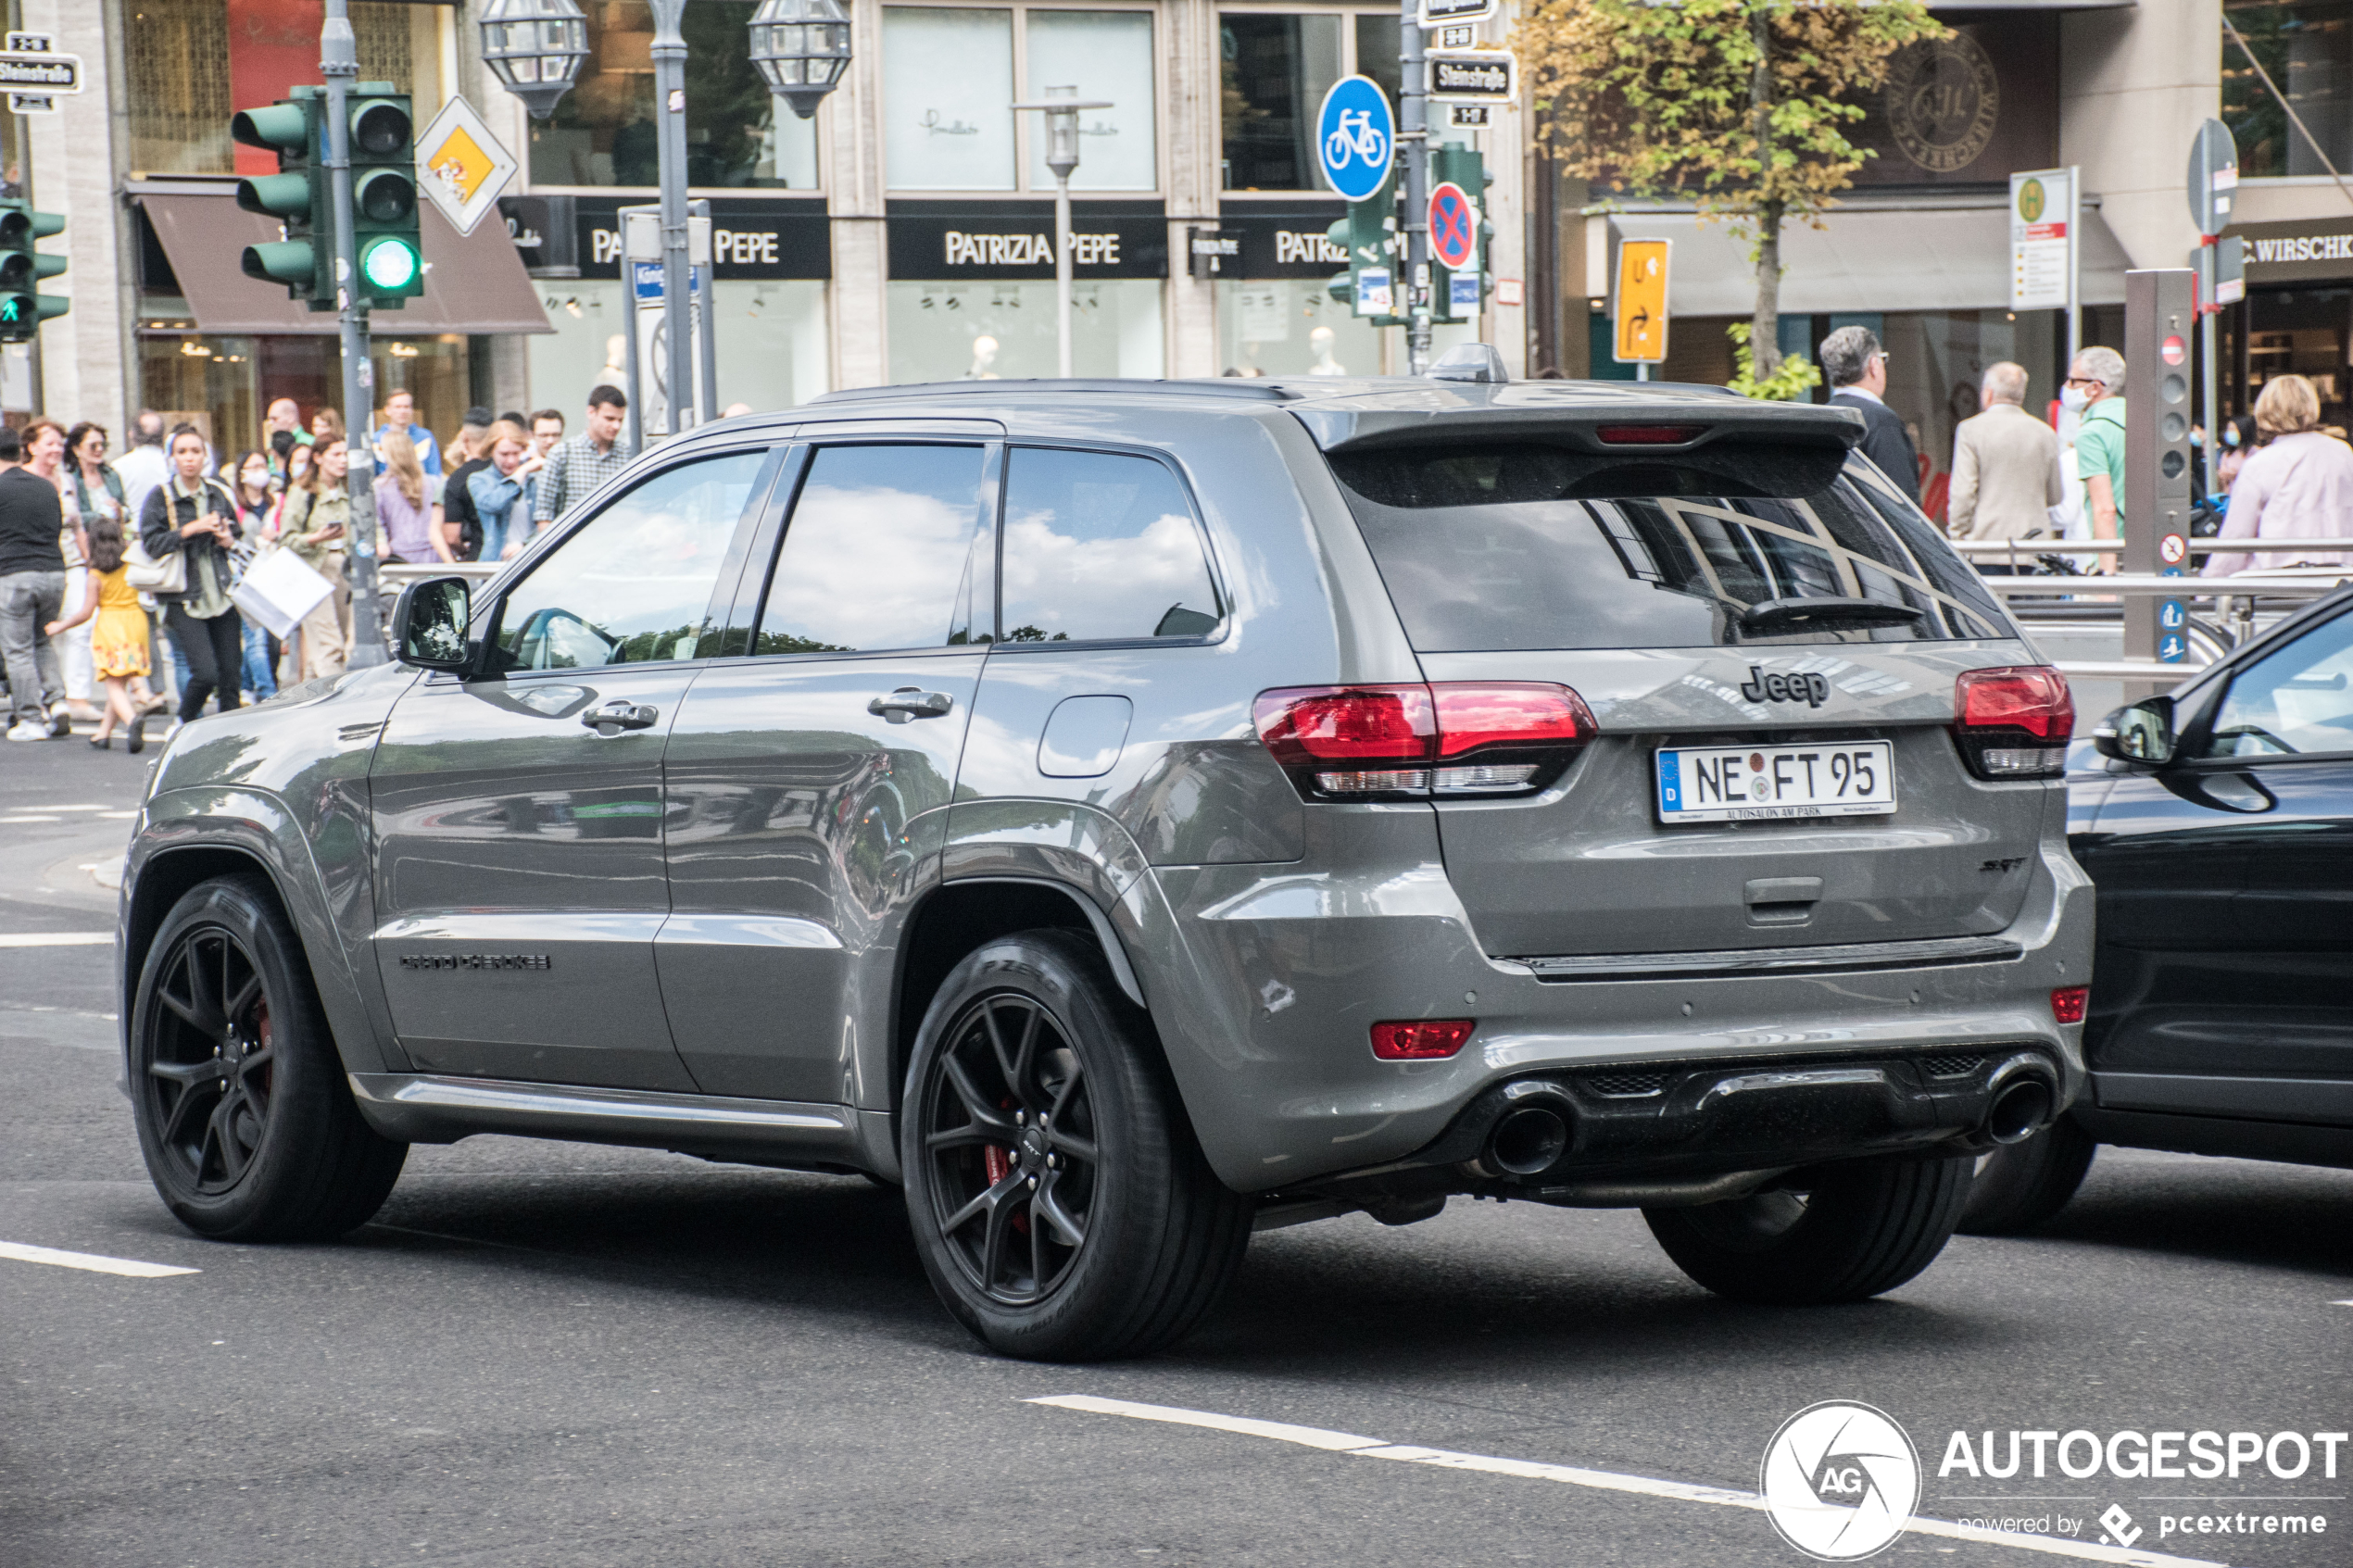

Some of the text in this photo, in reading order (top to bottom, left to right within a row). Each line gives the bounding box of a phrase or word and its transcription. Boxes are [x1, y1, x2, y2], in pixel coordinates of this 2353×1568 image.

[1438, 64, 1506, 90] Steinstraße
[714, 230, 780, 264] PEPE
[945, 231, 1055, 265] PATRIZIA
[1741, 665, 1831, 709] Jeep
[1695, 751, 1876, 803] NE FT 95
[1666, 787, 1677, 802] D
[1727, 807, 1821, 820] AUTOSALON AM PARK
